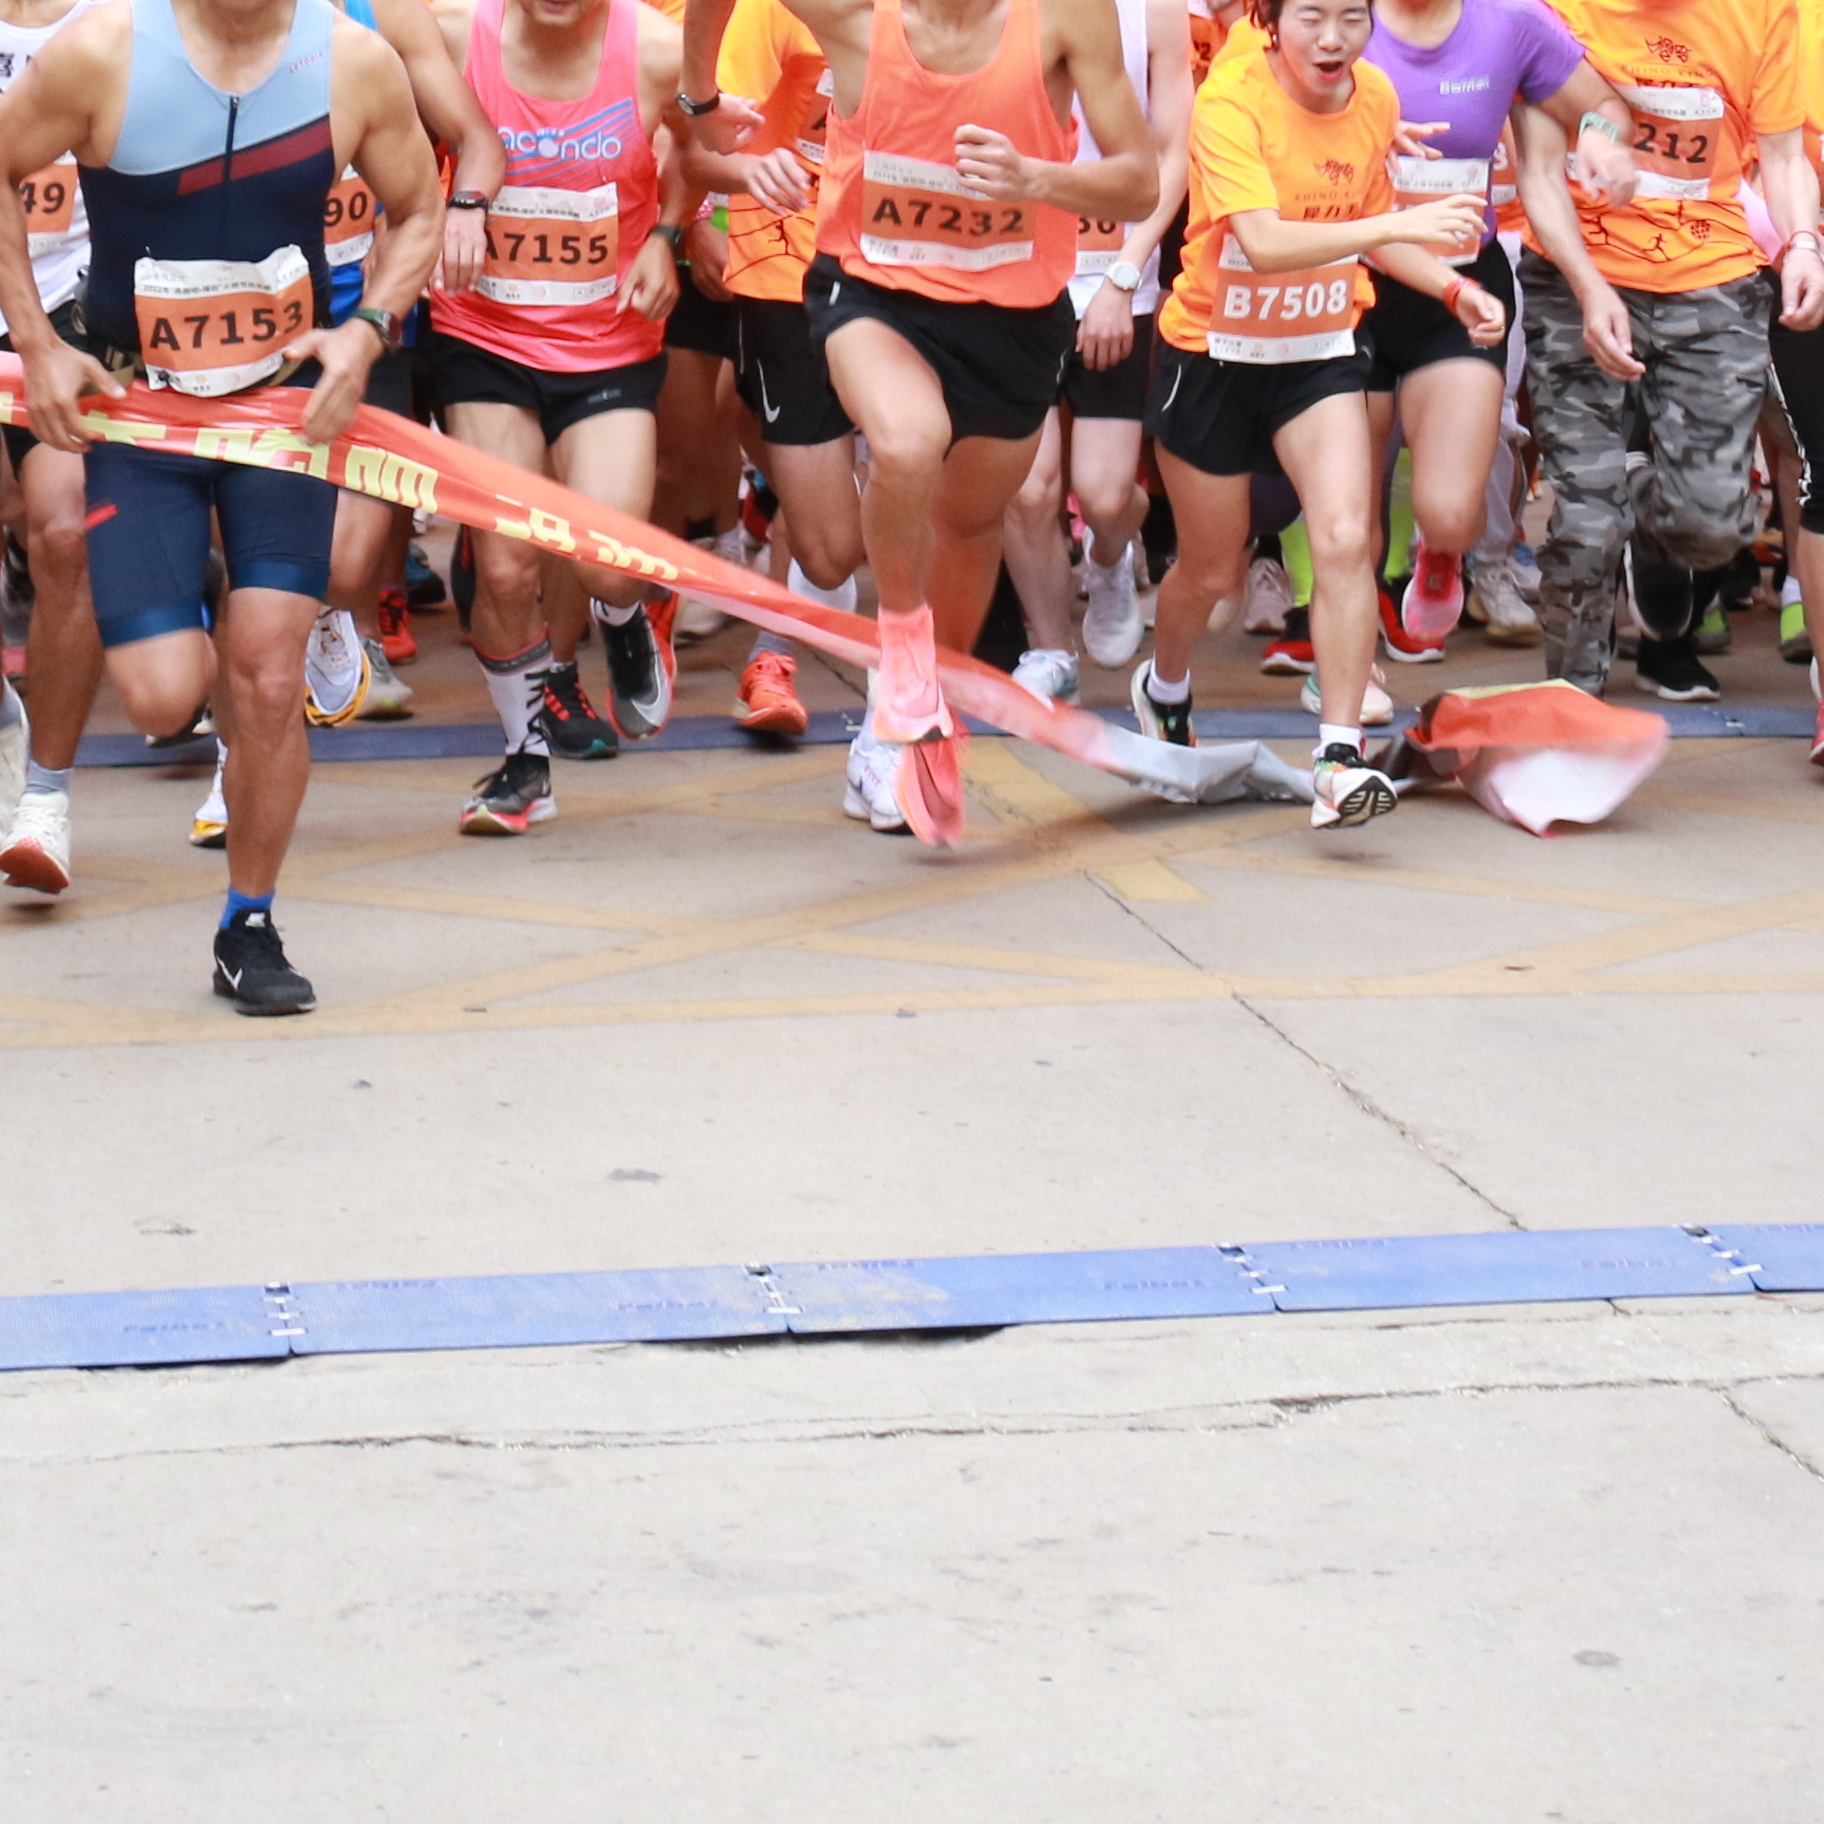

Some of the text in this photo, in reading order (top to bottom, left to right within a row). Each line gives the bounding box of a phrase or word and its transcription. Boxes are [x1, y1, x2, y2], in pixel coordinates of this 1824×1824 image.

[872, 196, 1025, 237] A7232
[1223, 278, 1349, 321] B7508
[148, 300, 304, 352] A7153
